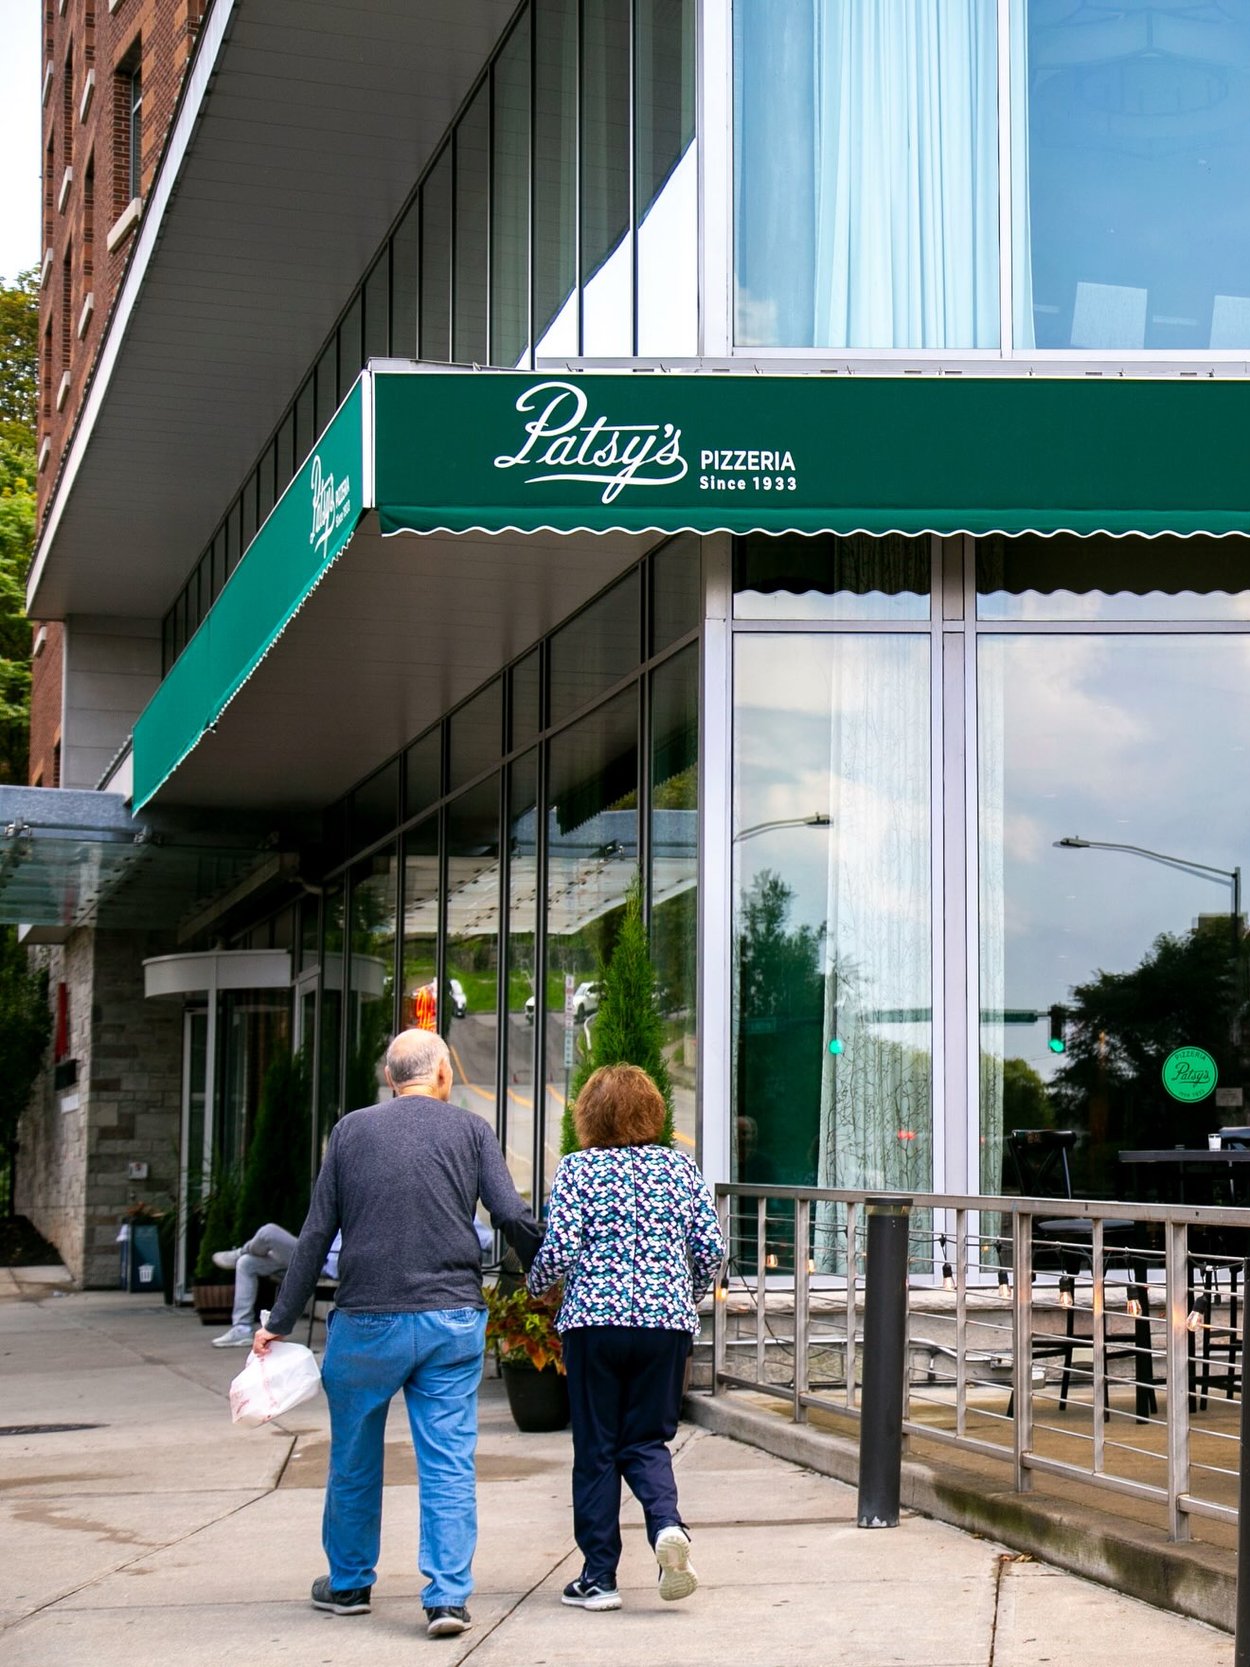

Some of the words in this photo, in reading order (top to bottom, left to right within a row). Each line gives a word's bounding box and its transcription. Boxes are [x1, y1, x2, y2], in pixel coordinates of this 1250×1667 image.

[494, 382, 688, 504] Patsy's
[700, 450, 796, 471] PIZZERIA
[700, 475, 746, 491] Since
[752, 476, 797, 491] 1933
